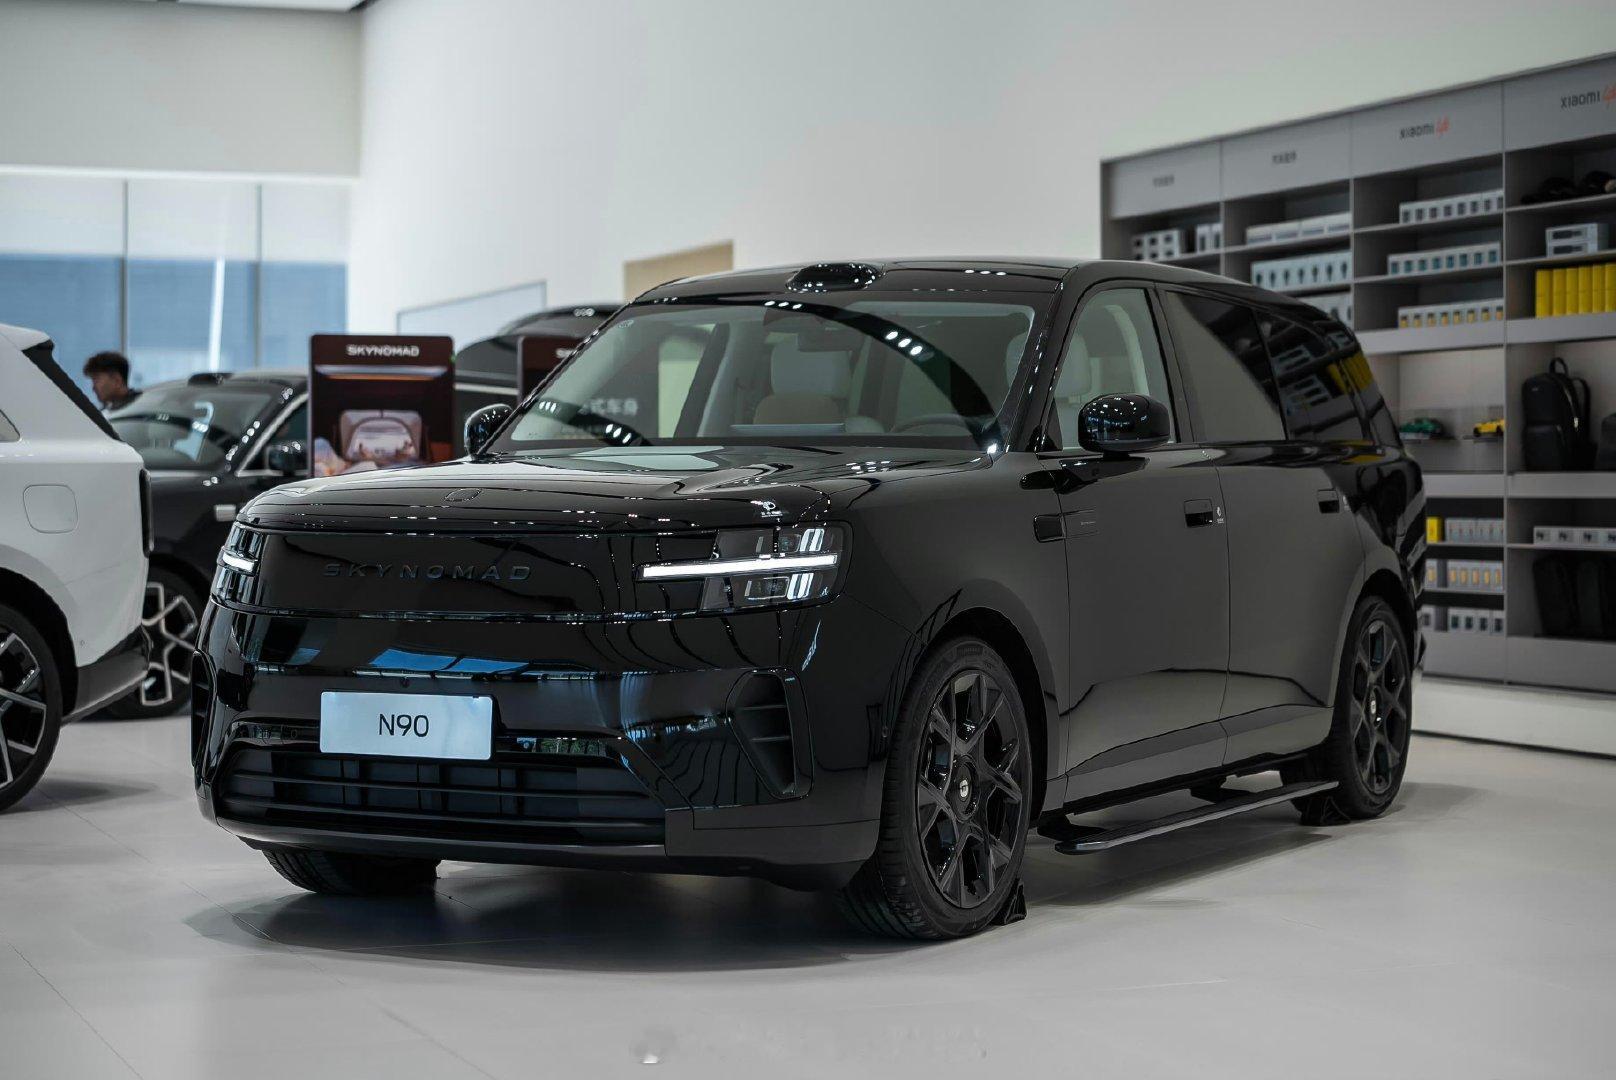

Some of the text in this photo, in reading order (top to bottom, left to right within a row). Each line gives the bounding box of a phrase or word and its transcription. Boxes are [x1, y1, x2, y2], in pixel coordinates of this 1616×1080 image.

[346, 344, 420, 357] SKYNOMAD
[322, 563, 531, 580] SKYNOMAD
[379, 713, 429, 737] N90
